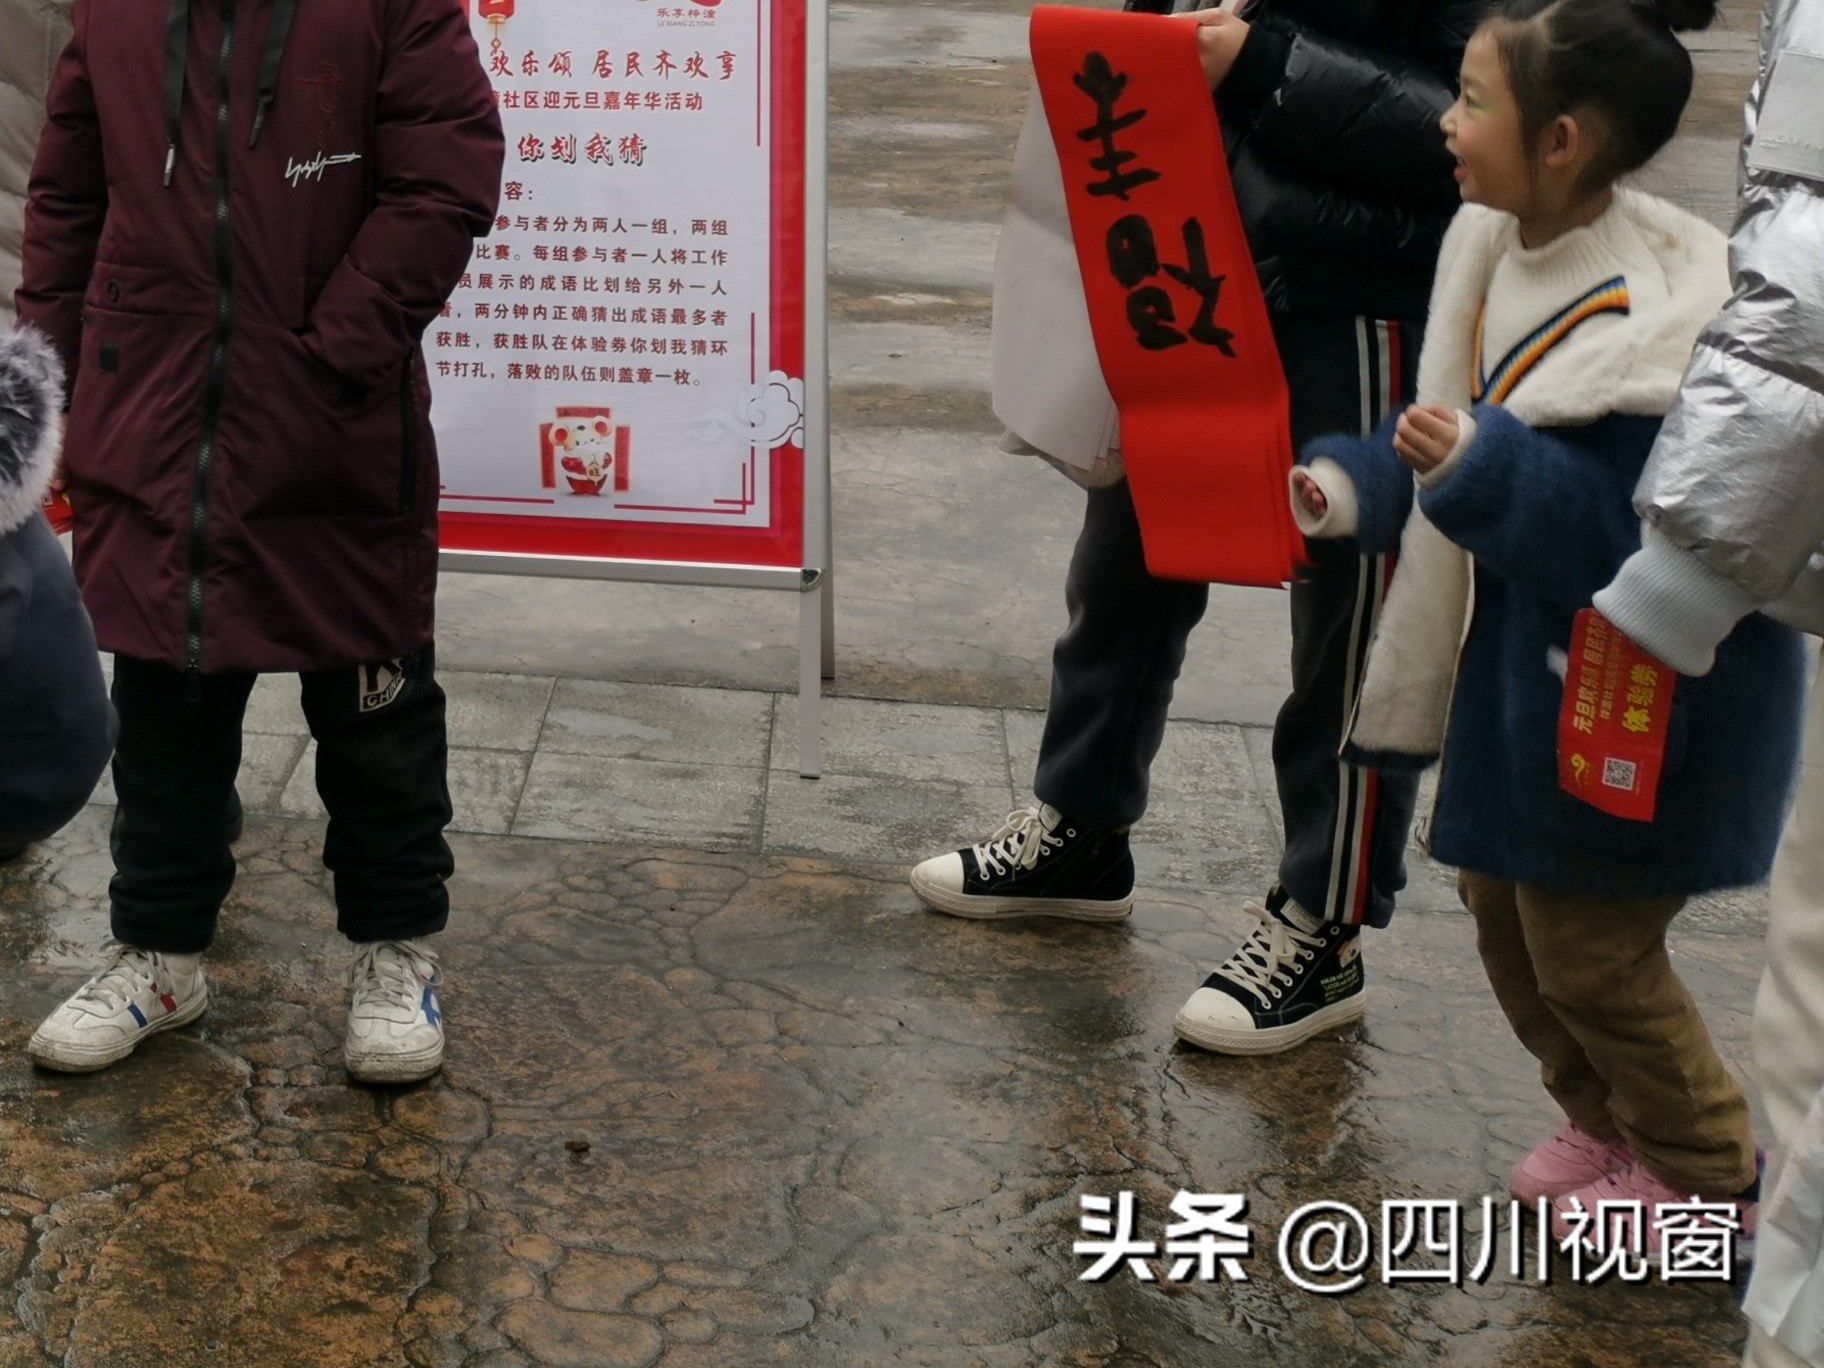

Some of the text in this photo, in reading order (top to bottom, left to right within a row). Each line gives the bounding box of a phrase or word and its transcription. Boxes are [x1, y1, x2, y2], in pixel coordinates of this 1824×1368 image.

[488, 49, 738, 81] 欢乐颂 居民齐欢享
[516, 132, 647, 166] 你划我猜
[494, 214, 729, 236] 参与者分为两人一组，两组
[475, 243, 729, 266] 比赛。每组参与者一人将工作
[458, 272, 728, 296] 员展示的成语比划给另外一人
[435, 360, 701, 387] 节打孔，落败的队伍则盖章一枚。
